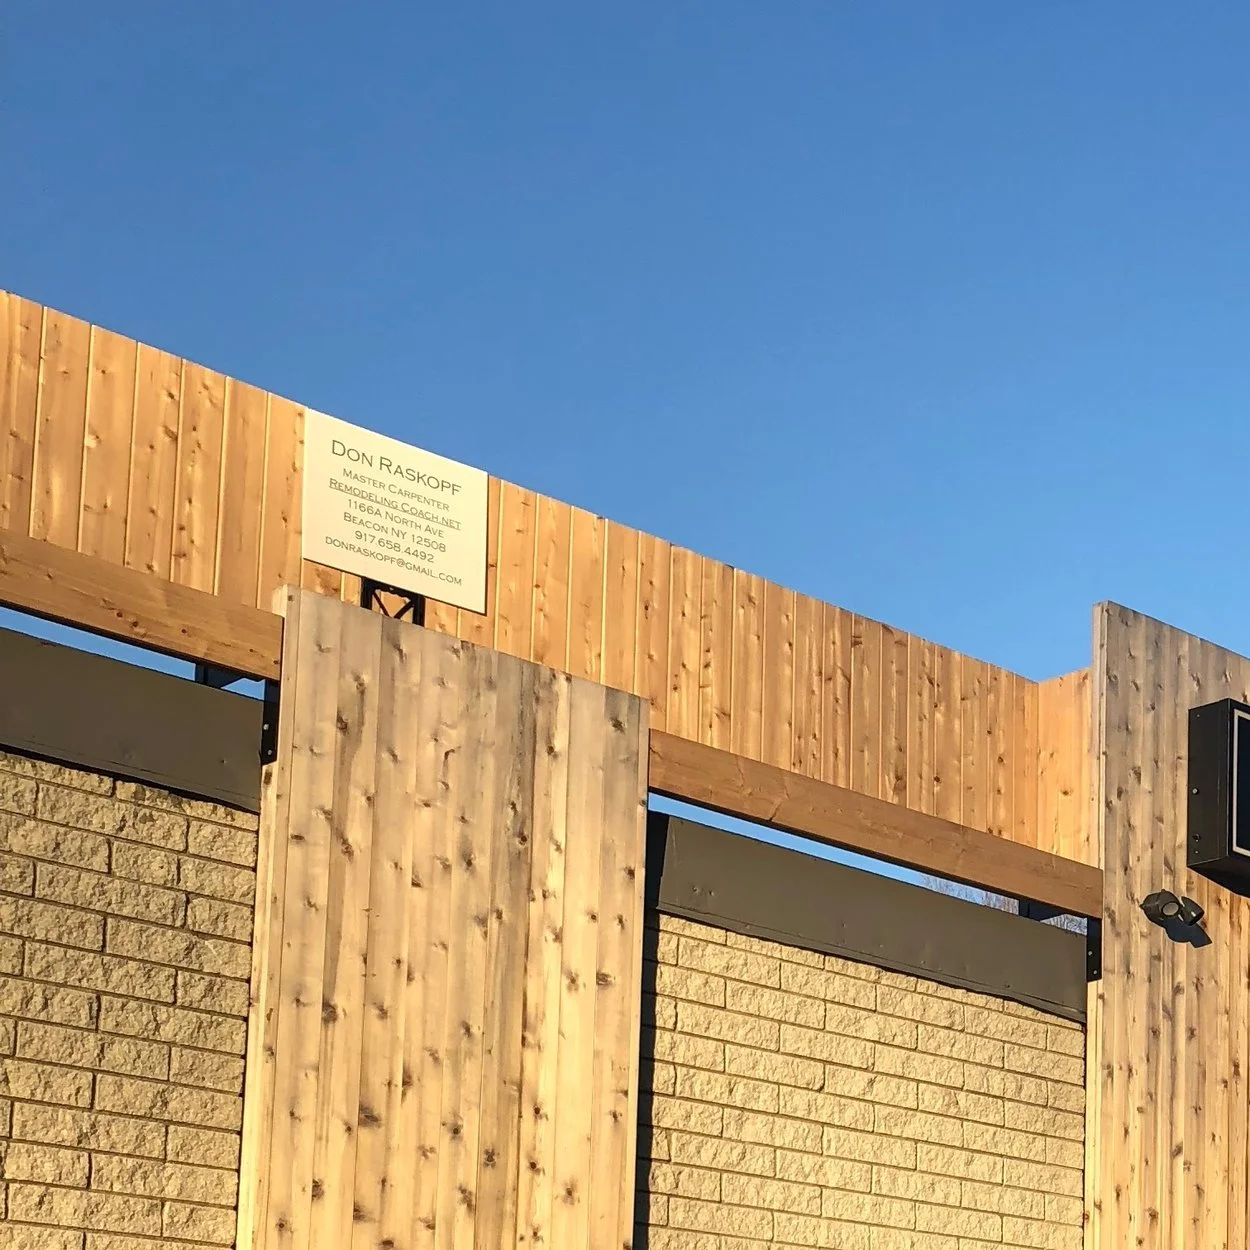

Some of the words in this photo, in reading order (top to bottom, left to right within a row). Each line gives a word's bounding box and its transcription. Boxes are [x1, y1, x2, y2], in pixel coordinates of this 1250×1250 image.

[332, 440, 373, 467] DON
[380, 456, 462, 496] RASKOPF
[342, 468, 386, 490] MASTER
[388, 484, 450, 512] CARPENTER
[329, 478, 398, 510] REMODELING
[401, 502, 461, 529] COACH.NET
[348, 499, 382, 518] 1166A
[385, 511, 421, 530] NORTH
[424, 524, 444, 538] AVE
[344, 512, 389, 534] BEACON
[391, 527, 407, 540] NY
[411, 534, 446, 553] 12508
[355, 530, 434, 563] 917.658.4492
[325, 536, 462, 586] DONRASKOPF@GMAIL.COM
